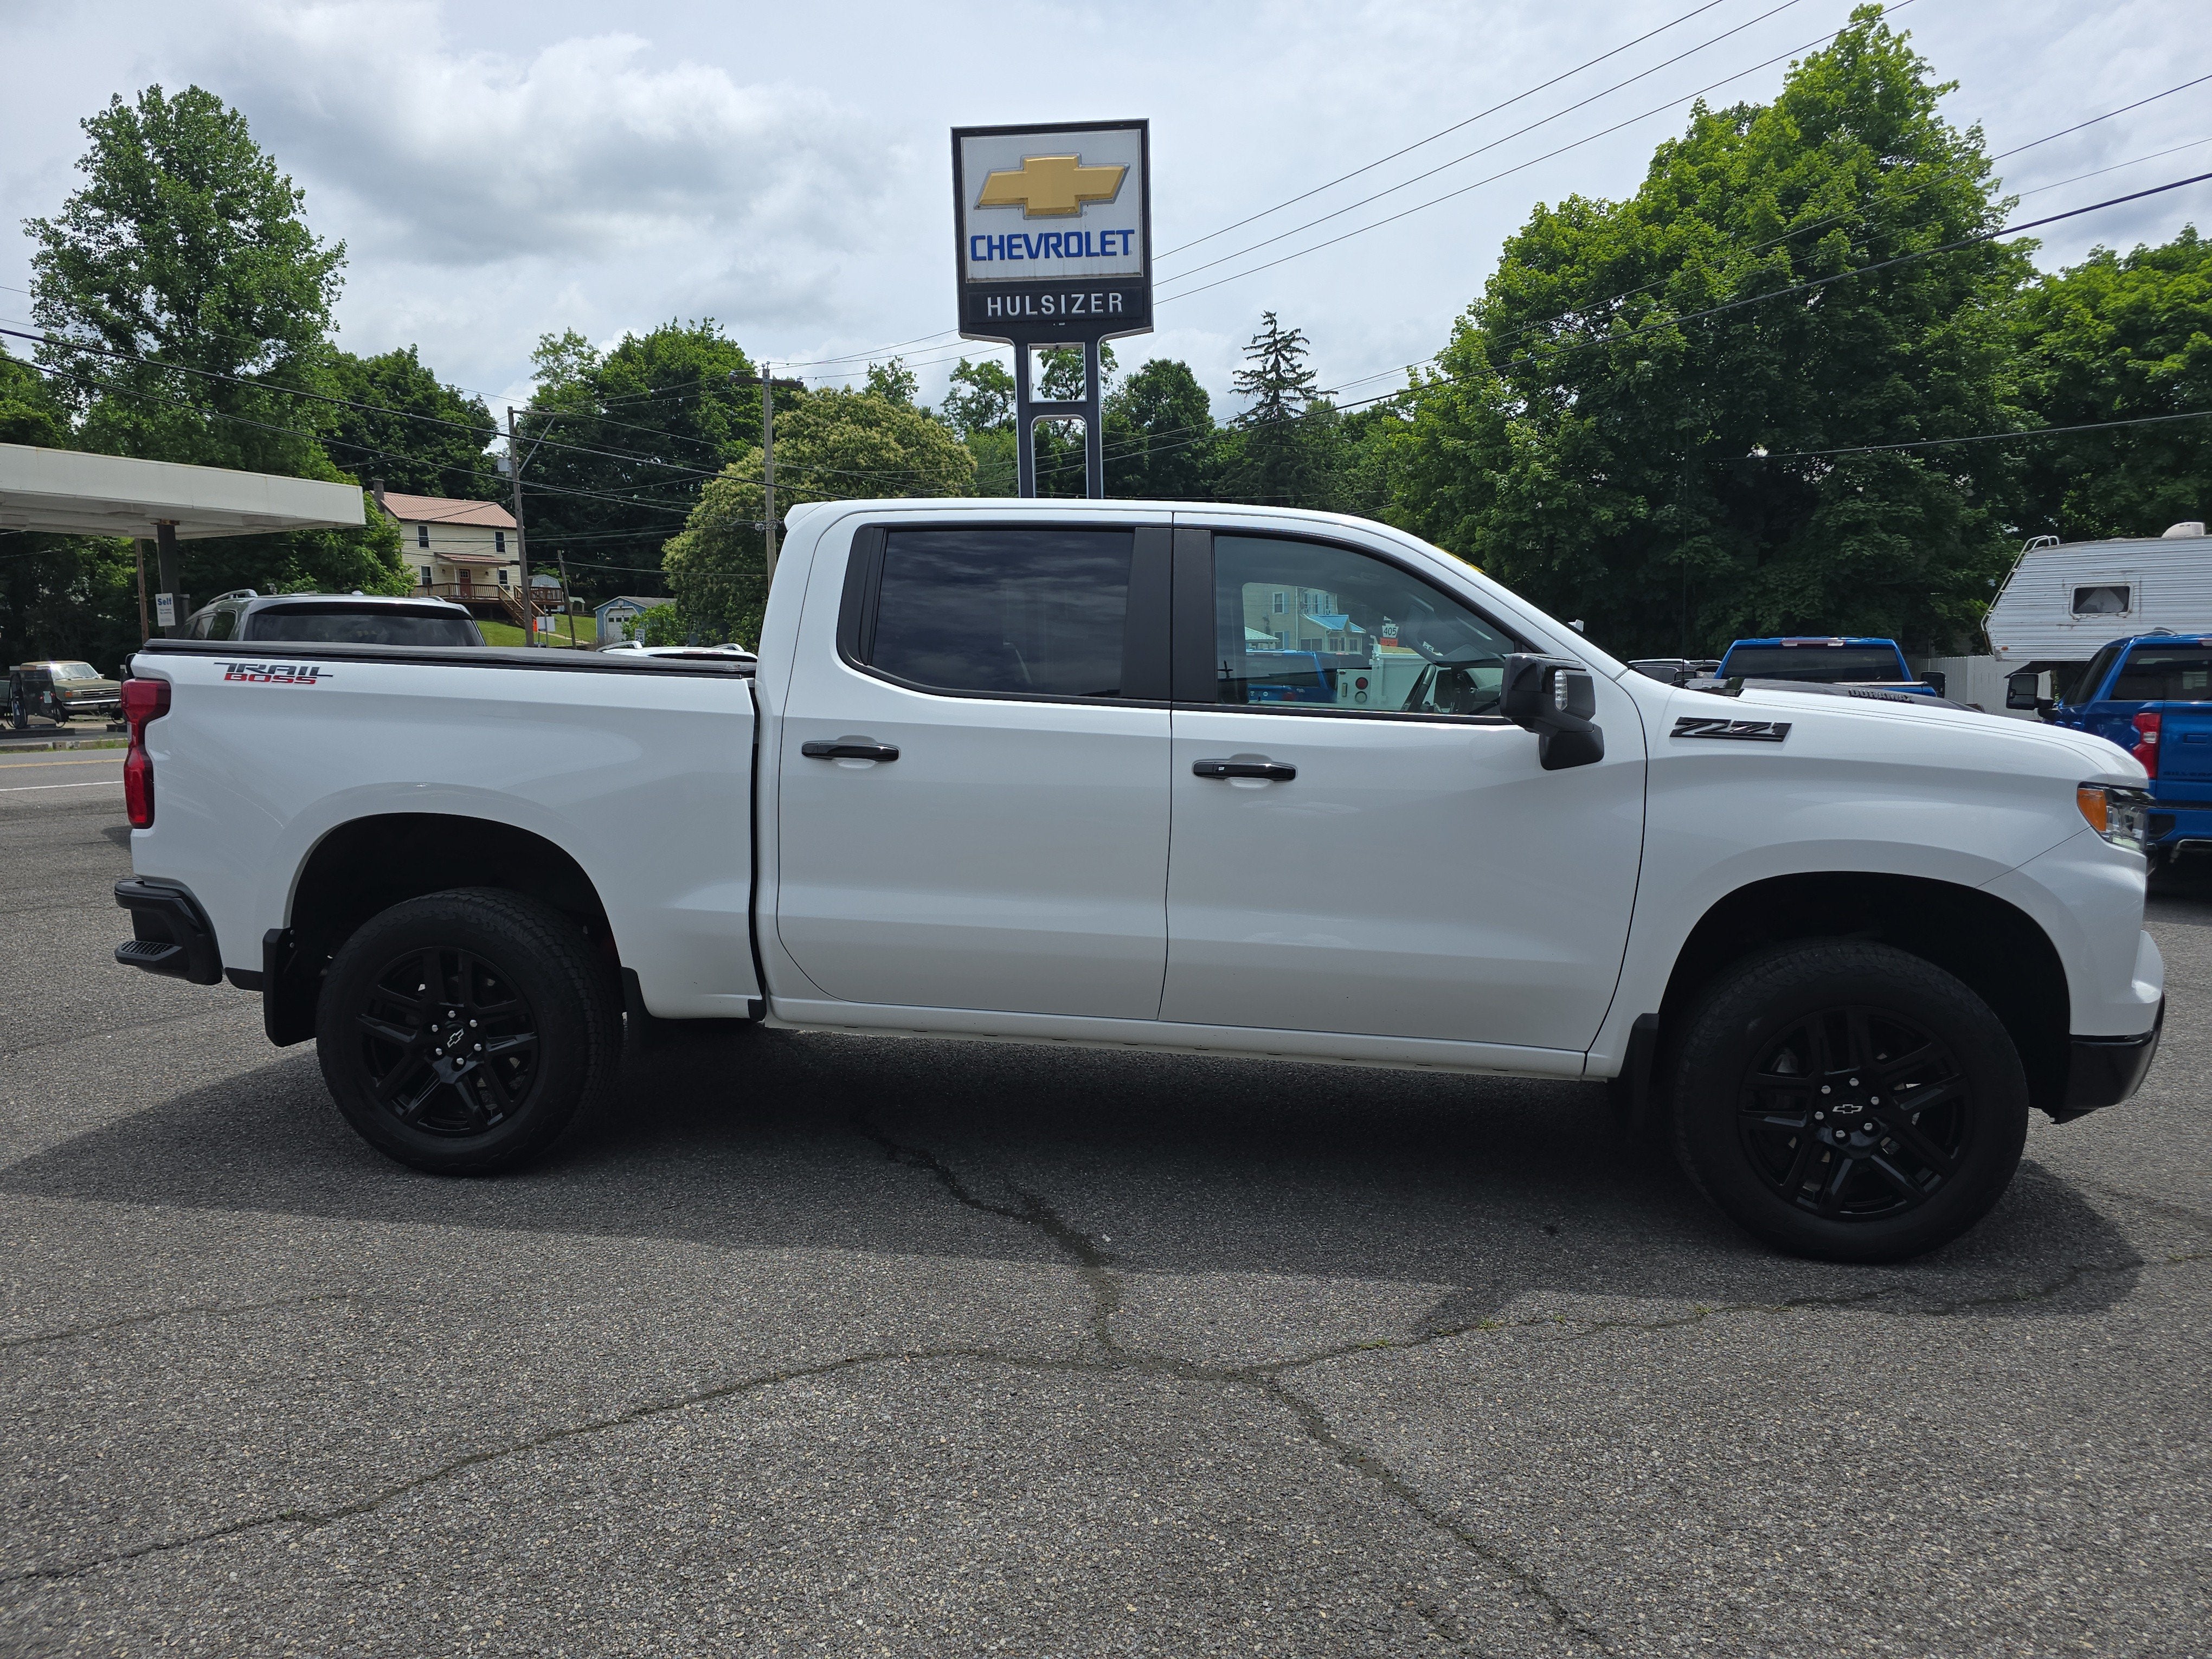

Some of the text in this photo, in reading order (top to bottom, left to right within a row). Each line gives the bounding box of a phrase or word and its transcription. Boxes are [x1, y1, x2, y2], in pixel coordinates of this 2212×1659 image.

[970, 229, 1135, 261] CHEVROLET
[987, 293, 1123, 317] HULSIZER
[158, 597, 172, 606] Self
[1383, 627, 1397, 635] 405
[214, 662, 333, 677] TRAIL
[224, 672, 318, 685] BOSS
[1848, 688, 1915, 704] DURAMAX
[1669, 716, 1793, 742] Z71
